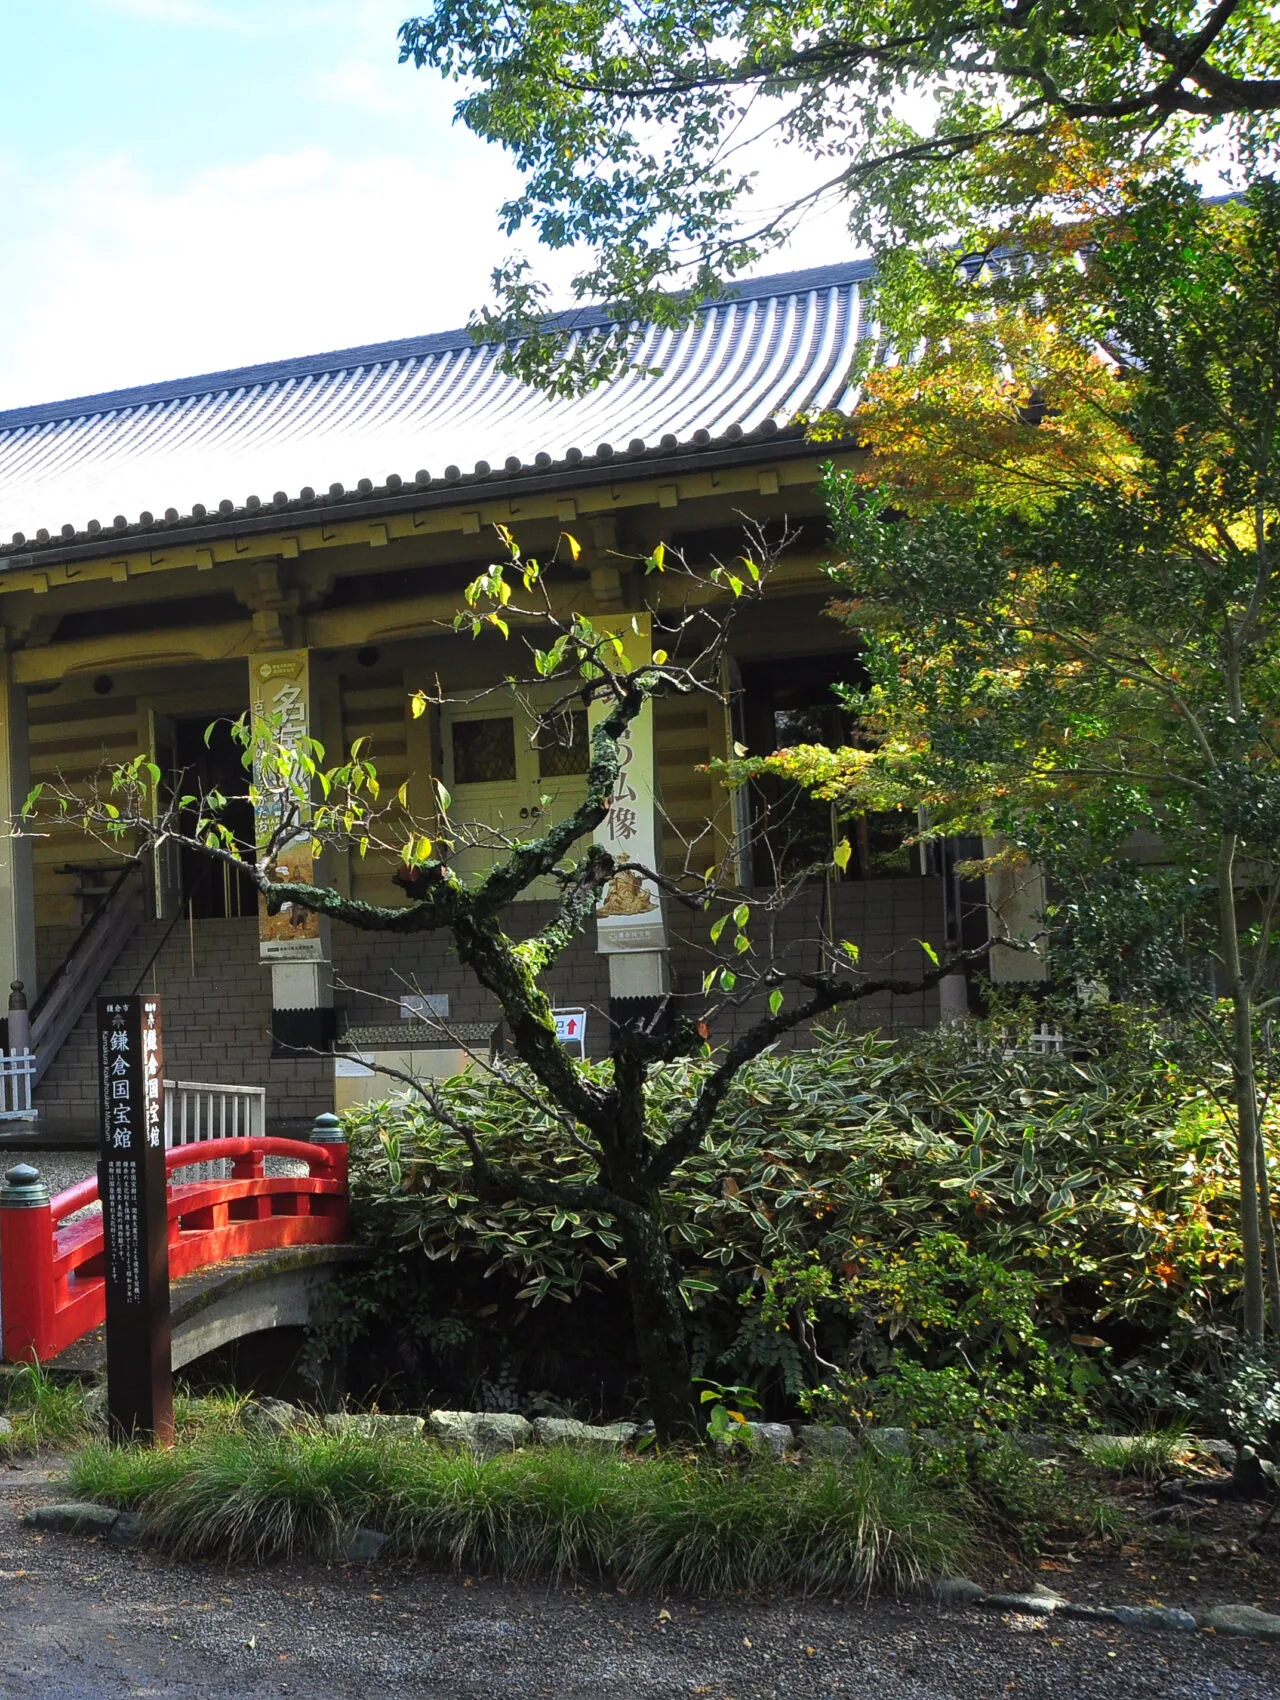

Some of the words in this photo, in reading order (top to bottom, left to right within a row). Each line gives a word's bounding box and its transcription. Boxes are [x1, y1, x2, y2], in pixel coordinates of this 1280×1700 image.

[110, 1030, 132, 1149] 鎌倉国宝館
